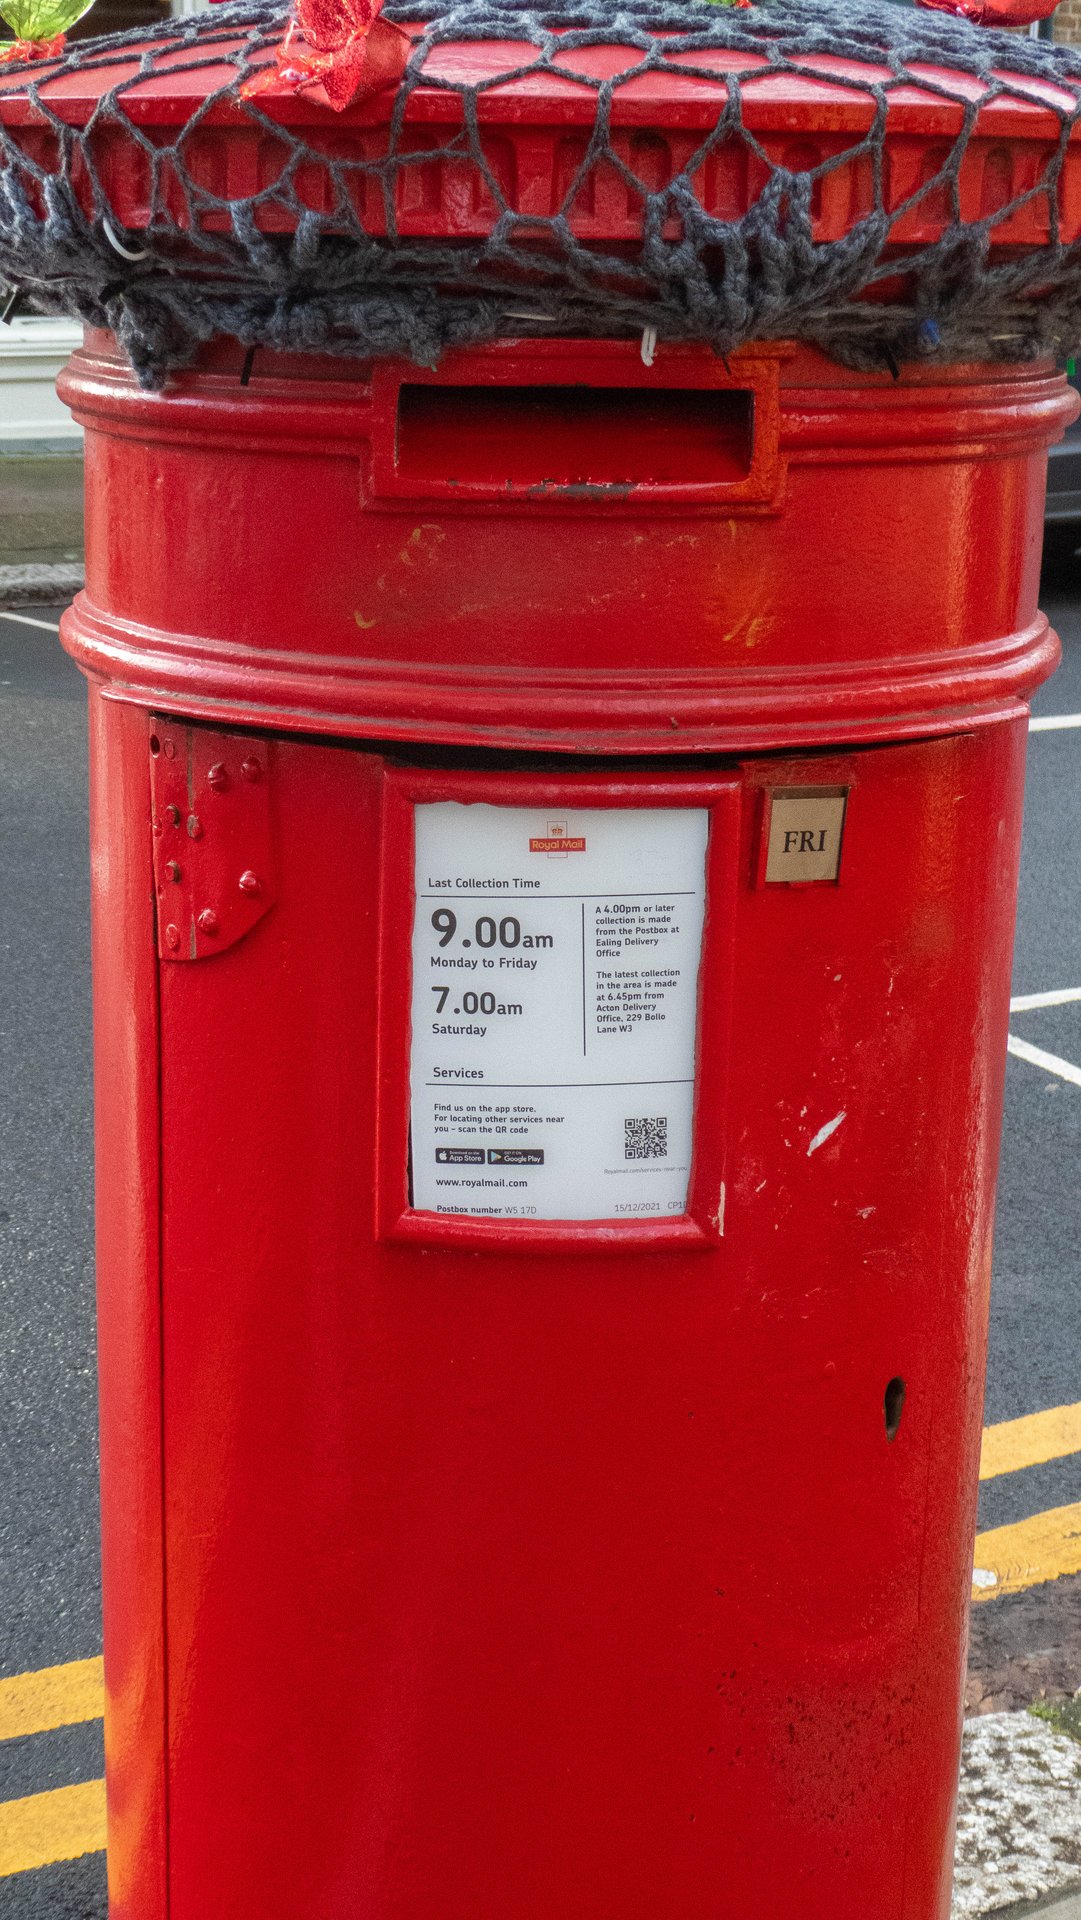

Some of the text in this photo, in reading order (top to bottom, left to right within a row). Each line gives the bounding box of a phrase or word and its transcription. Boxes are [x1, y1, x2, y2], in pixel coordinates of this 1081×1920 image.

[532, 840, 582, 850] Royal Mail
[782, 830, 827, 853] FRI
[428, 878, 540, 888] Last Collection Time
[604, 905, 640, 914] 4.00pm
[431, 908, 553, 948] 9.00am
[625, 938, 658, 946] Delivery
[596, 949, 620, 957] Office
[431, 956, 537, 970] Monday to Friday
[615, 970, 638, 978] latest
[641, 969, 680, 977] collection
[432, 986, 522, 1015] 7.00am
[608, 993, 641, 1001] 6.45pm
[623, 1003, 656, 1011] Delivery
[432, 1024, 486, 1036] Saturday
[433, 1067, 484, 1078] Services
[450, 1115, 482, 1123] locating
[436, 1179, 528, 1187] www.royalmail.com
[437, 1205, 468, 1213] Postbox
[521, 1206, 536, 1214] 17D
[615, 1203, 660, 1212] 15/12/2021
